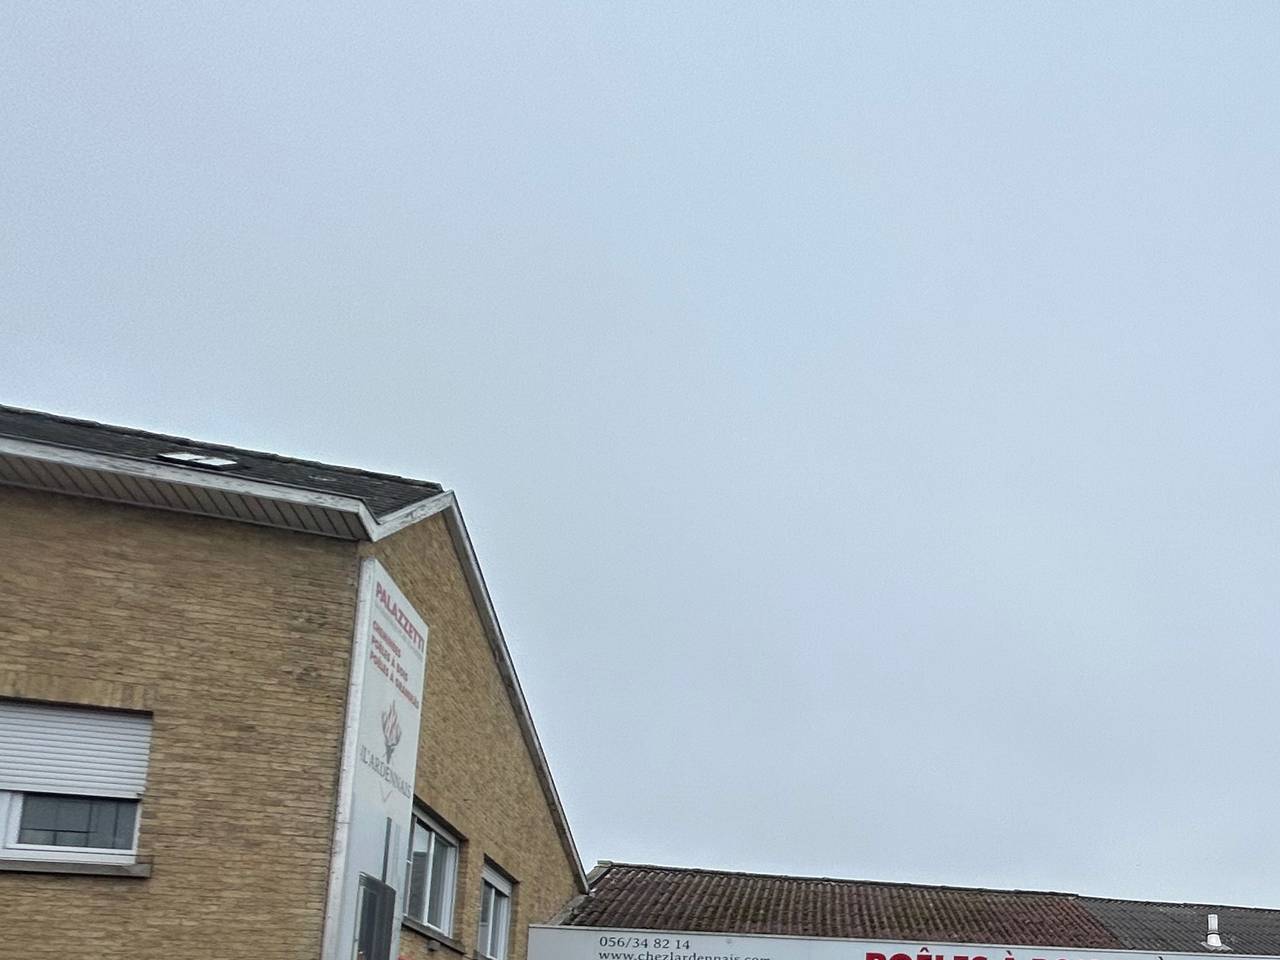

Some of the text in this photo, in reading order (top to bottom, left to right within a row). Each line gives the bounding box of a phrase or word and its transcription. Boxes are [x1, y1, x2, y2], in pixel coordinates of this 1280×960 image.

[376, 582, 424, 653] PALAZZETTI
[599, 936, 690, 949] 056/34 82 14
